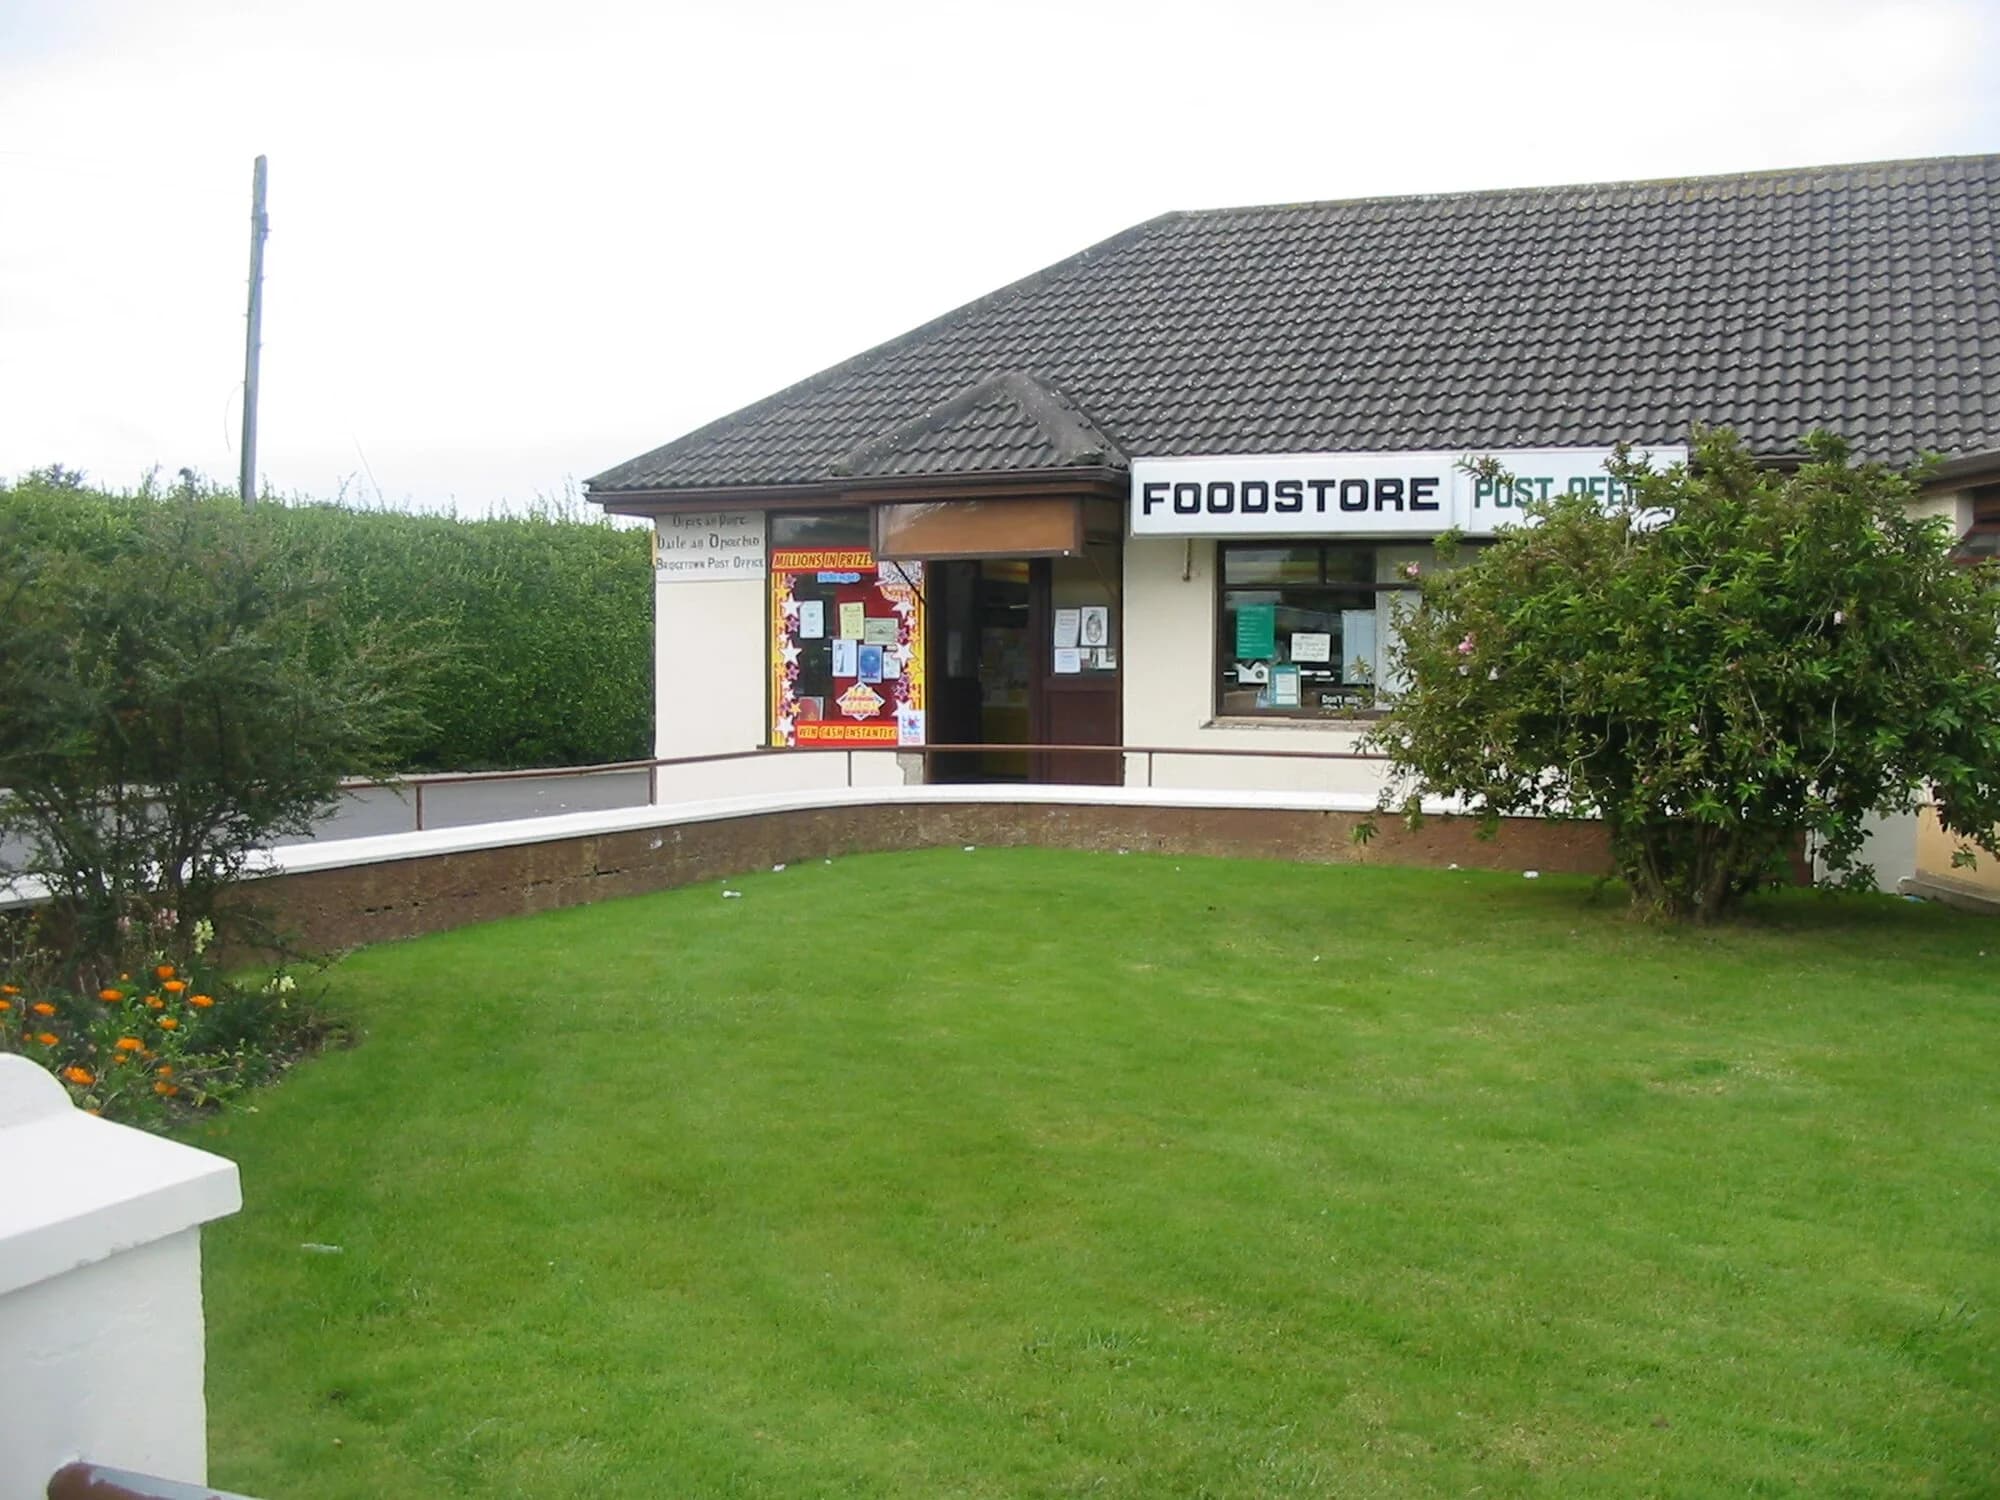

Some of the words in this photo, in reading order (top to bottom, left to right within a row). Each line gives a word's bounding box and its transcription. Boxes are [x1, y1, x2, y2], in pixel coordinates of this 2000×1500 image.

[1143, 477, 1439, 515] FOODSTORE
[1474, 477, 1553, 509] POST
[773, 552, 823, 568] MILLIONS
[823, 552, 838, 567] IN
[799, 726, 818, 738] WIN
[819, 726, 845, 738] CASH
